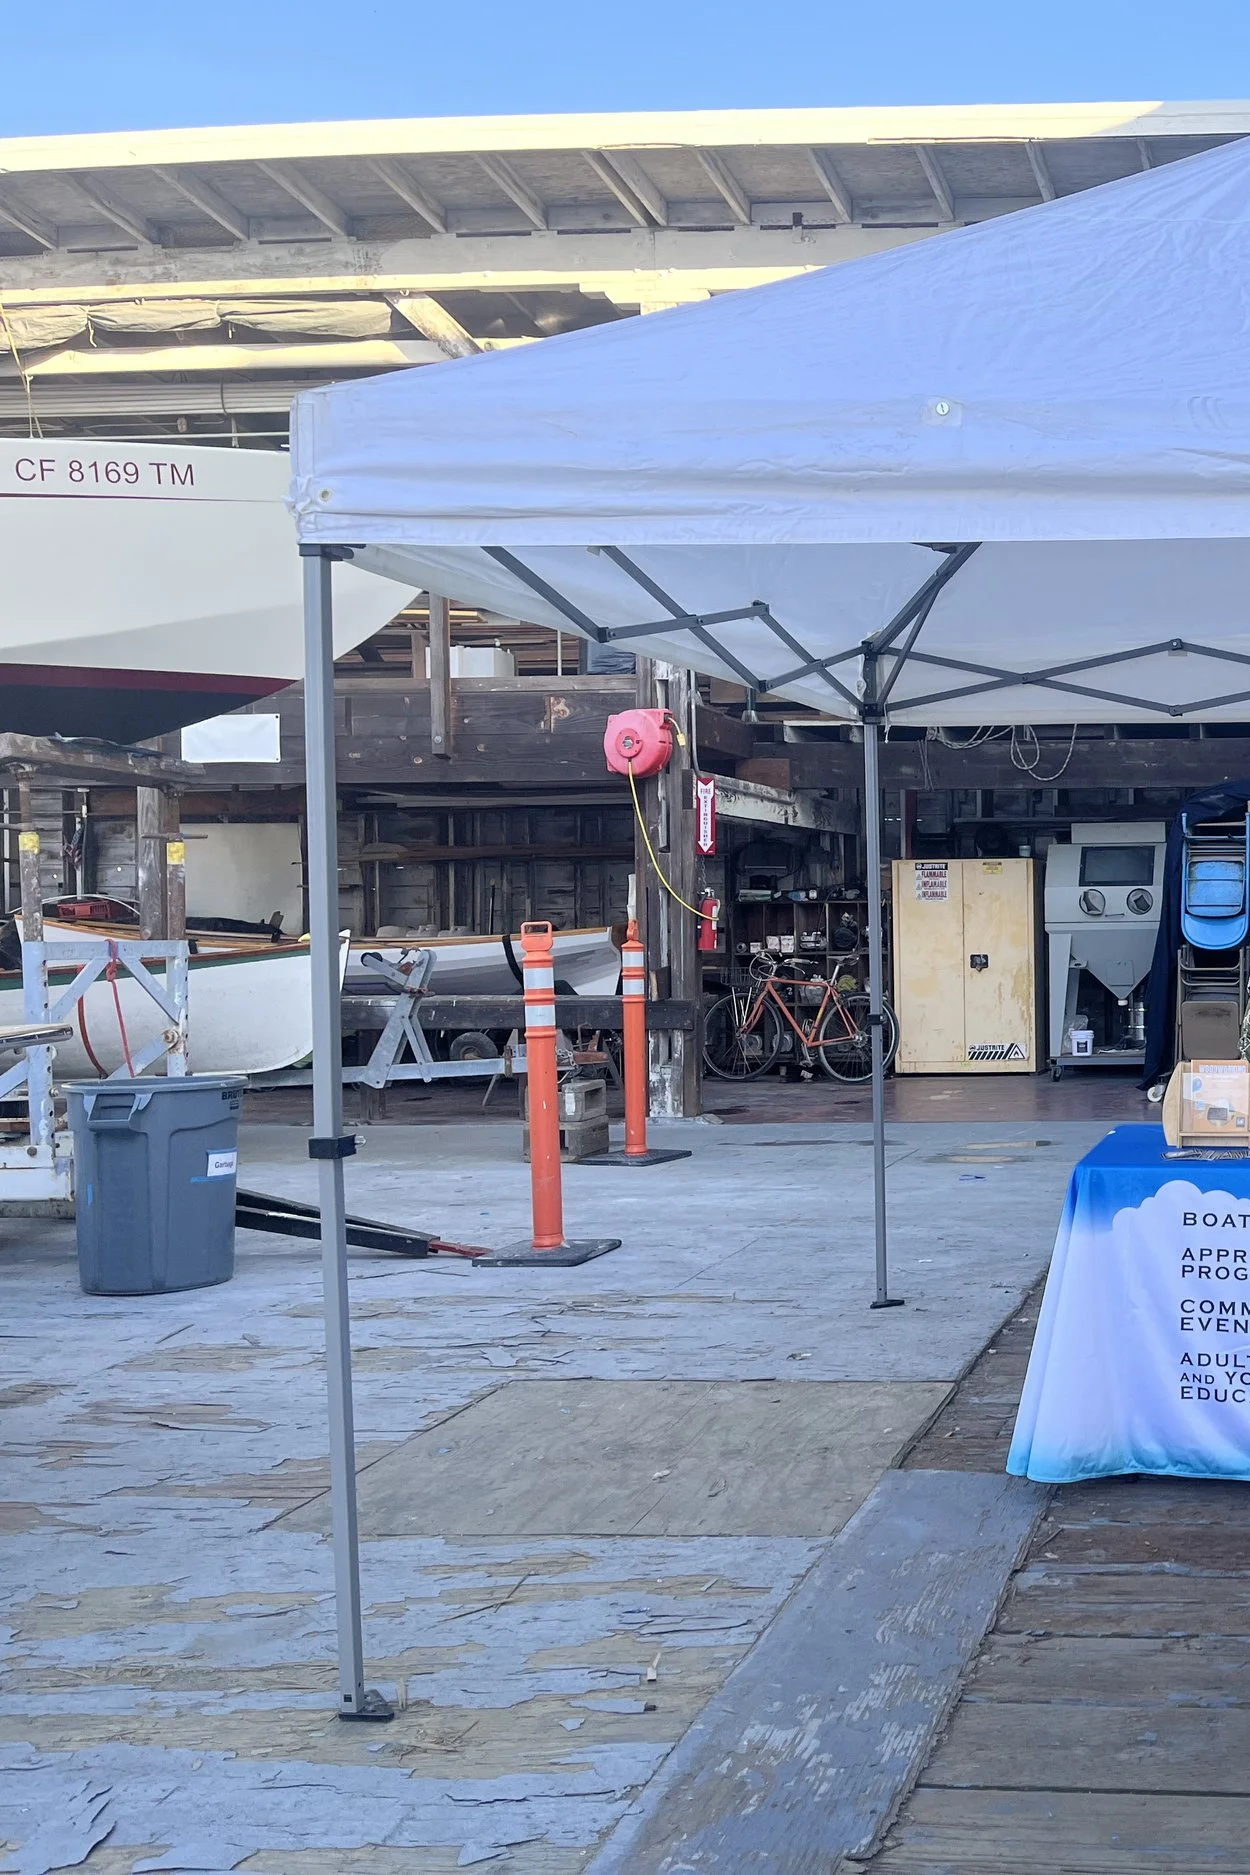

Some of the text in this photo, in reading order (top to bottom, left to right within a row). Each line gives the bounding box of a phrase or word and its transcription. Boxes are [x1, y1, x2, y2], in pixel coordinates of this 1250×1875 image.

[15, 458, 194, 486] CF 8169 TM
[1180, 1373, 1215, 1384] AND
